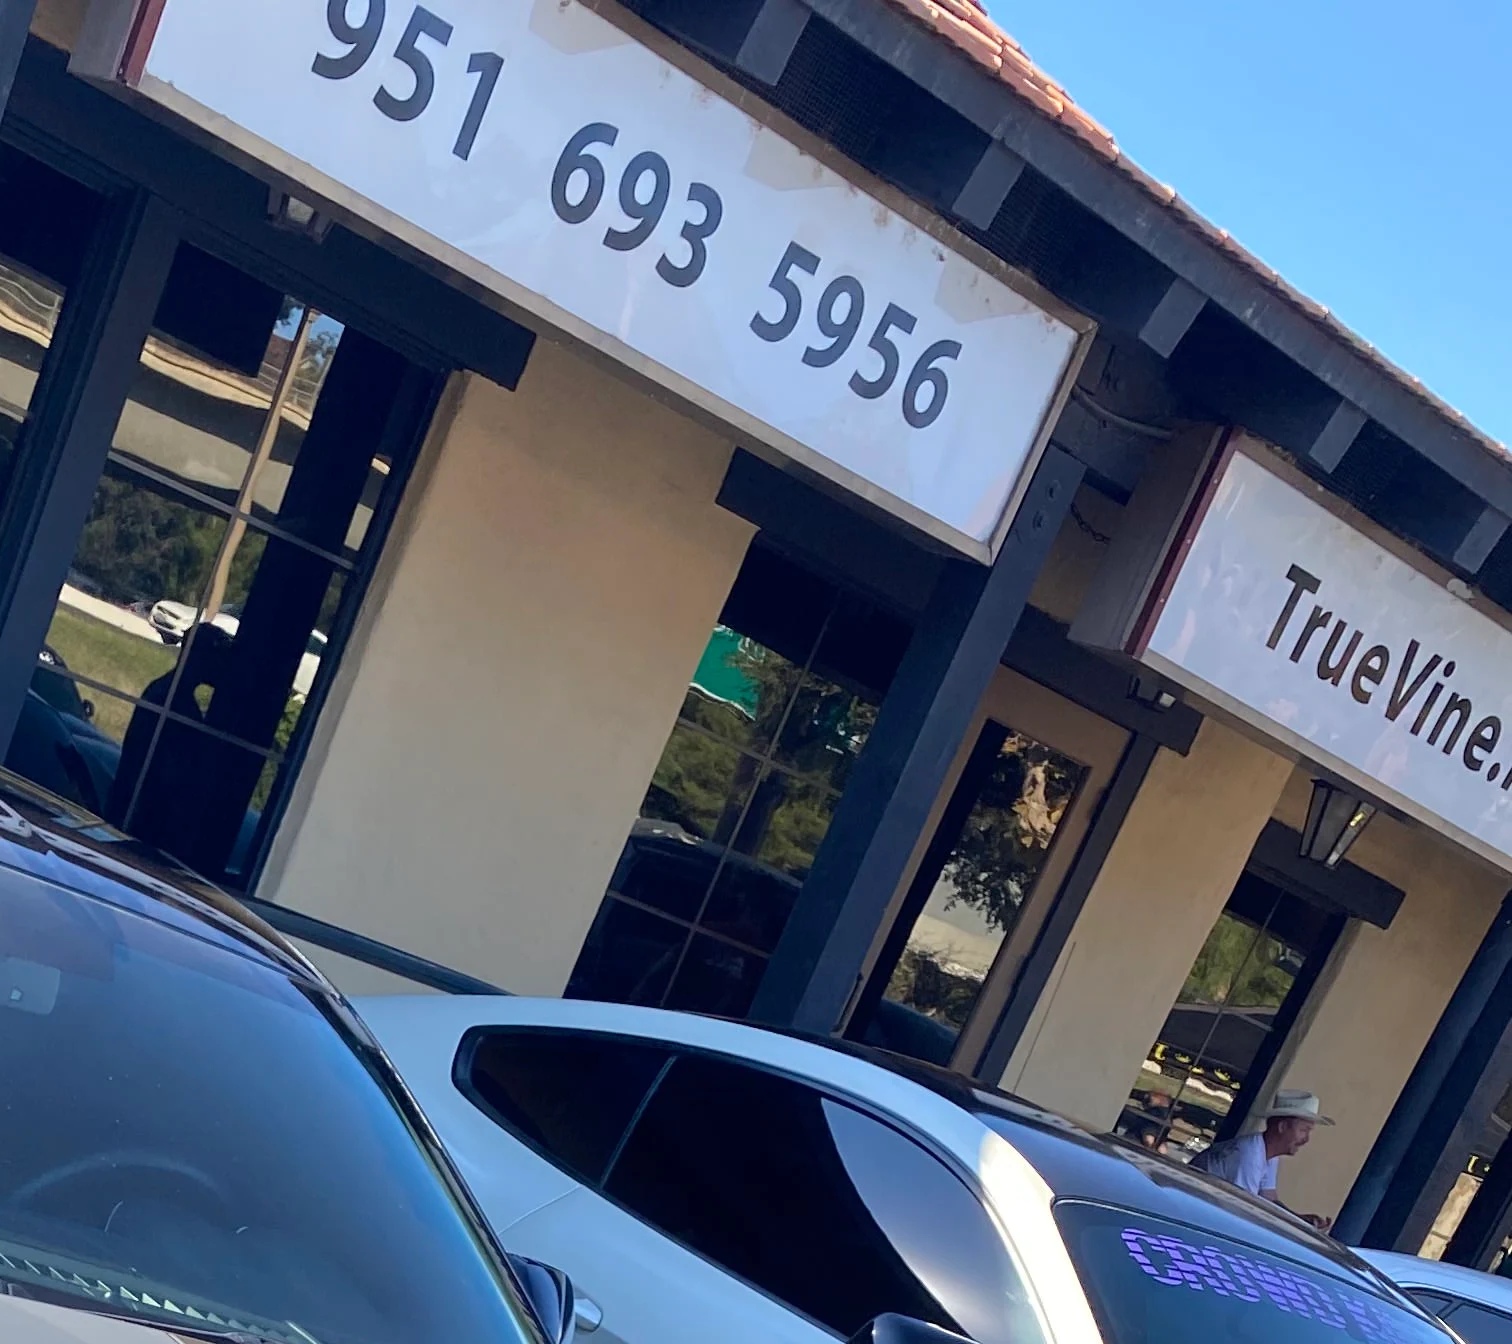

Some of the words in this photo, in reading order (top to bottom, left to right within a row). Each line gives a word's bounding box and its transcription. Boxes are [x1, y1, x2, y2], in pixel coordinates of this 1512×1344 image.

[310, 0, 505, 162] 951
[549, 122, 725, 288] 693
[748, 240, 963, 429] 5956
[1265, 563, 1512, 791] TrueVine.
